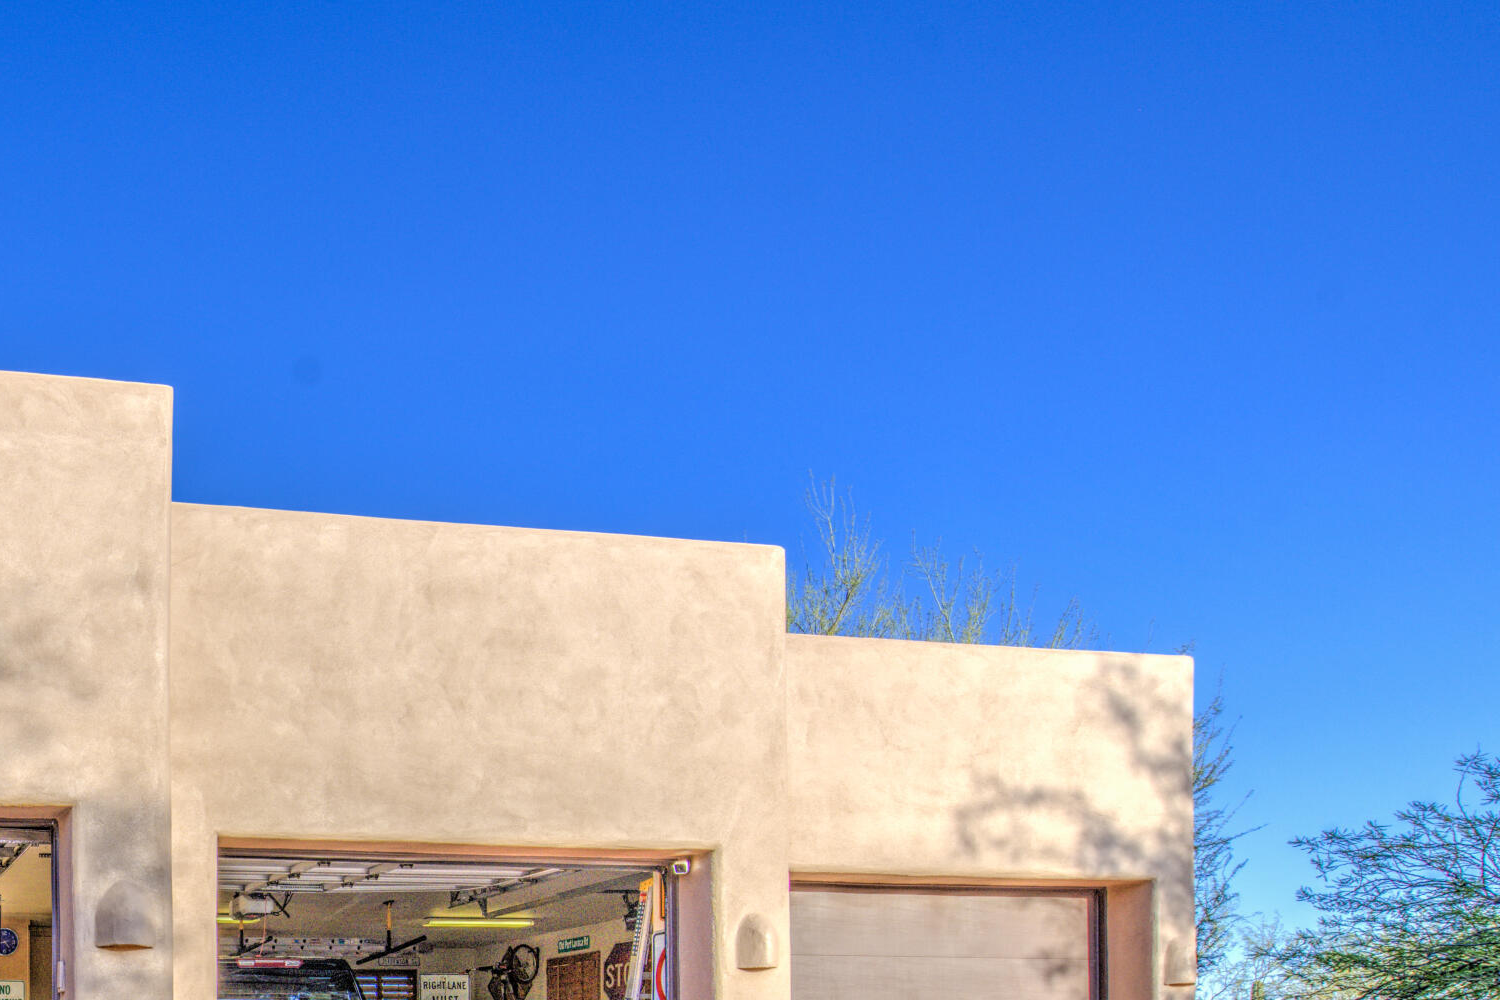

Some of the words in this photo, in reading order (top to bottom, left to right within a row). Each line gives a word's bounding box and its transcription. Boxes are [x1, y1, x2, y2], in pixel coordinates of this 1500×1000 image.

[0, 984, 11, 995] NO
[423, 981, 446, 990] RIGHT
[447, 981, 466, 990] LANE
